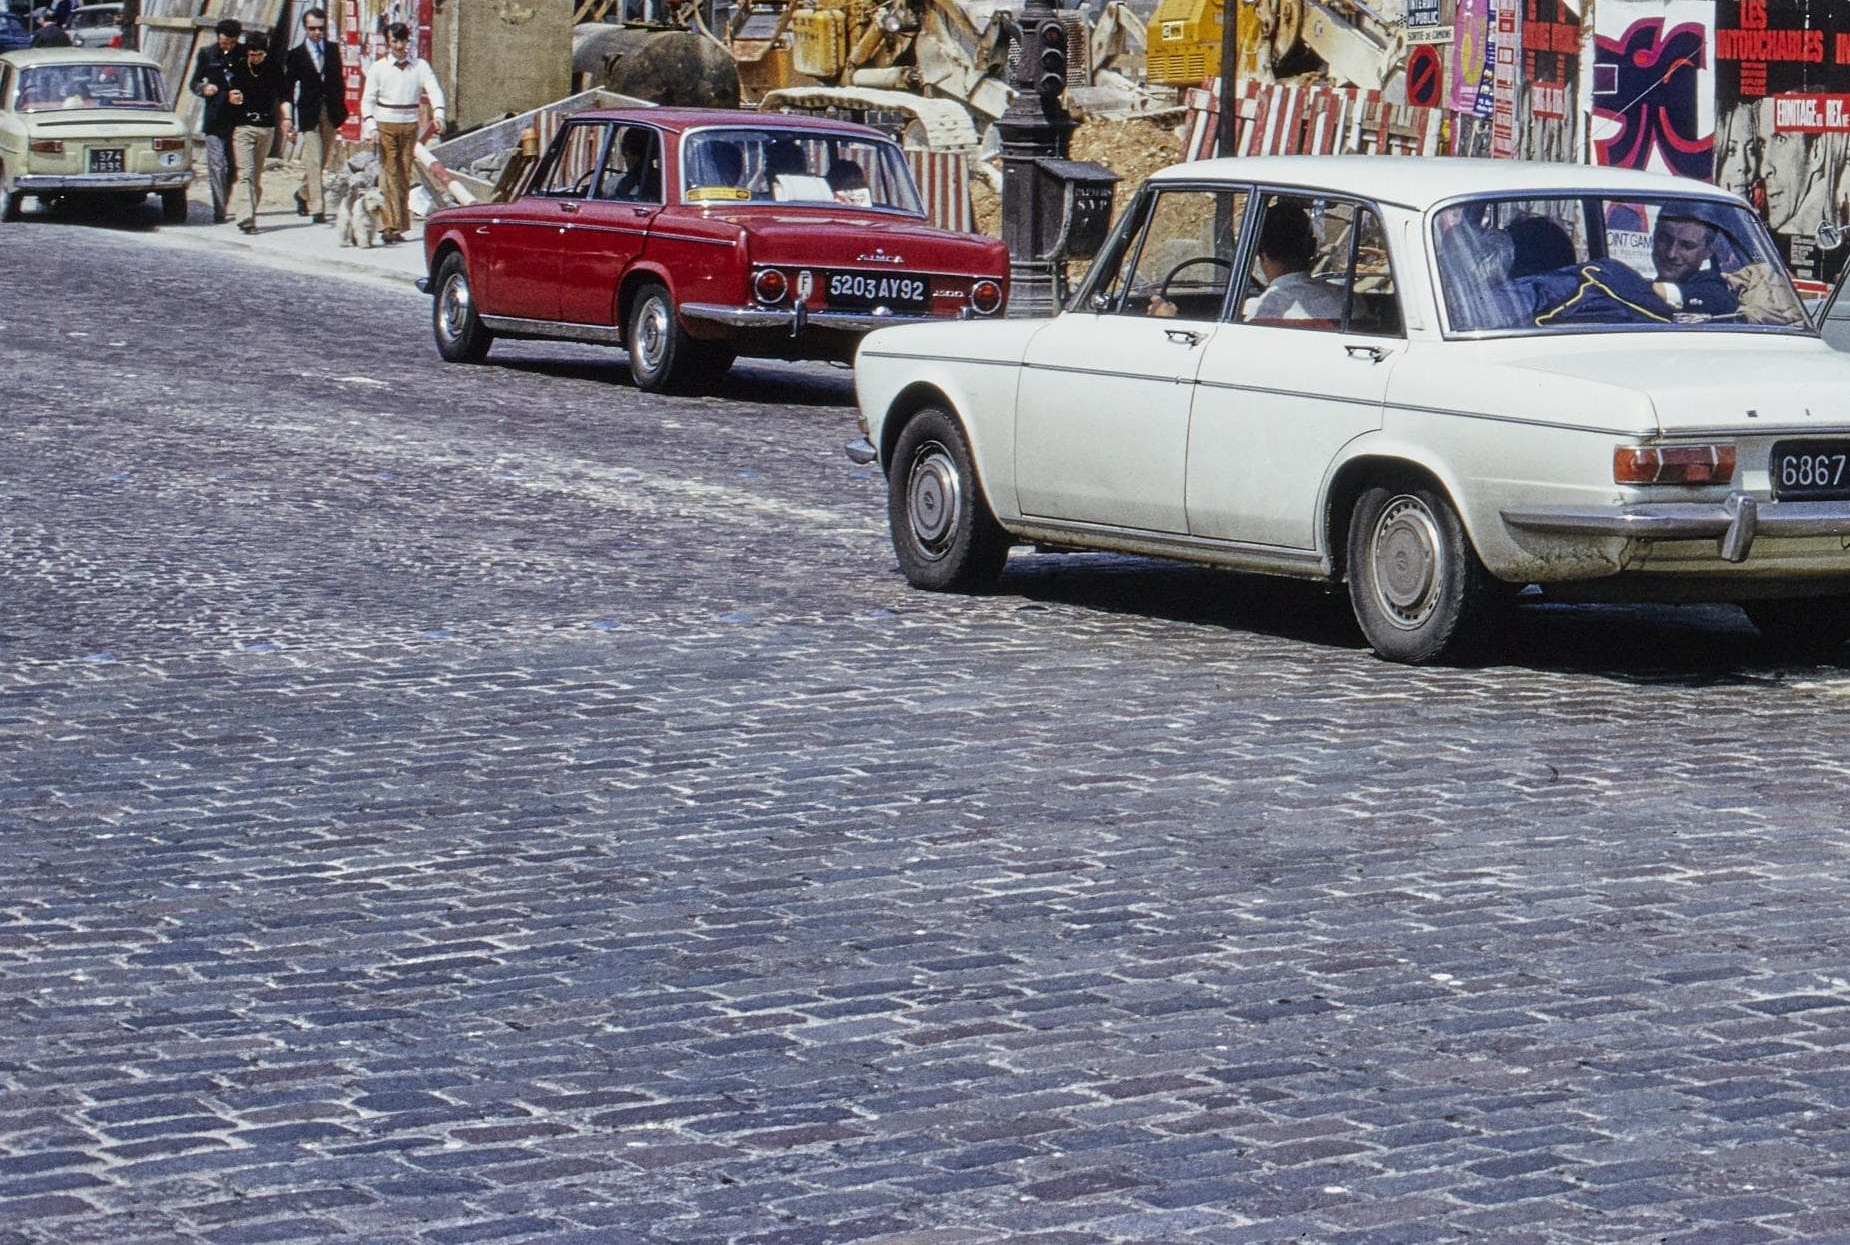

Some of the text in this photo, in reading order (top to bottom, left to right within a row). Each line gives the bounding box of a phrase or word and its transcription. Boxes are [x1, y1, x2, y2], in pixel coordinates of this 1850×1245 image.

[1415, 11, 1439, 25] PUBLIC
[1715, 29, 1823, 63] INTOUCHABLES
[1826, 99, 1843, 127] REX
[167, 154, 177, 166] F
